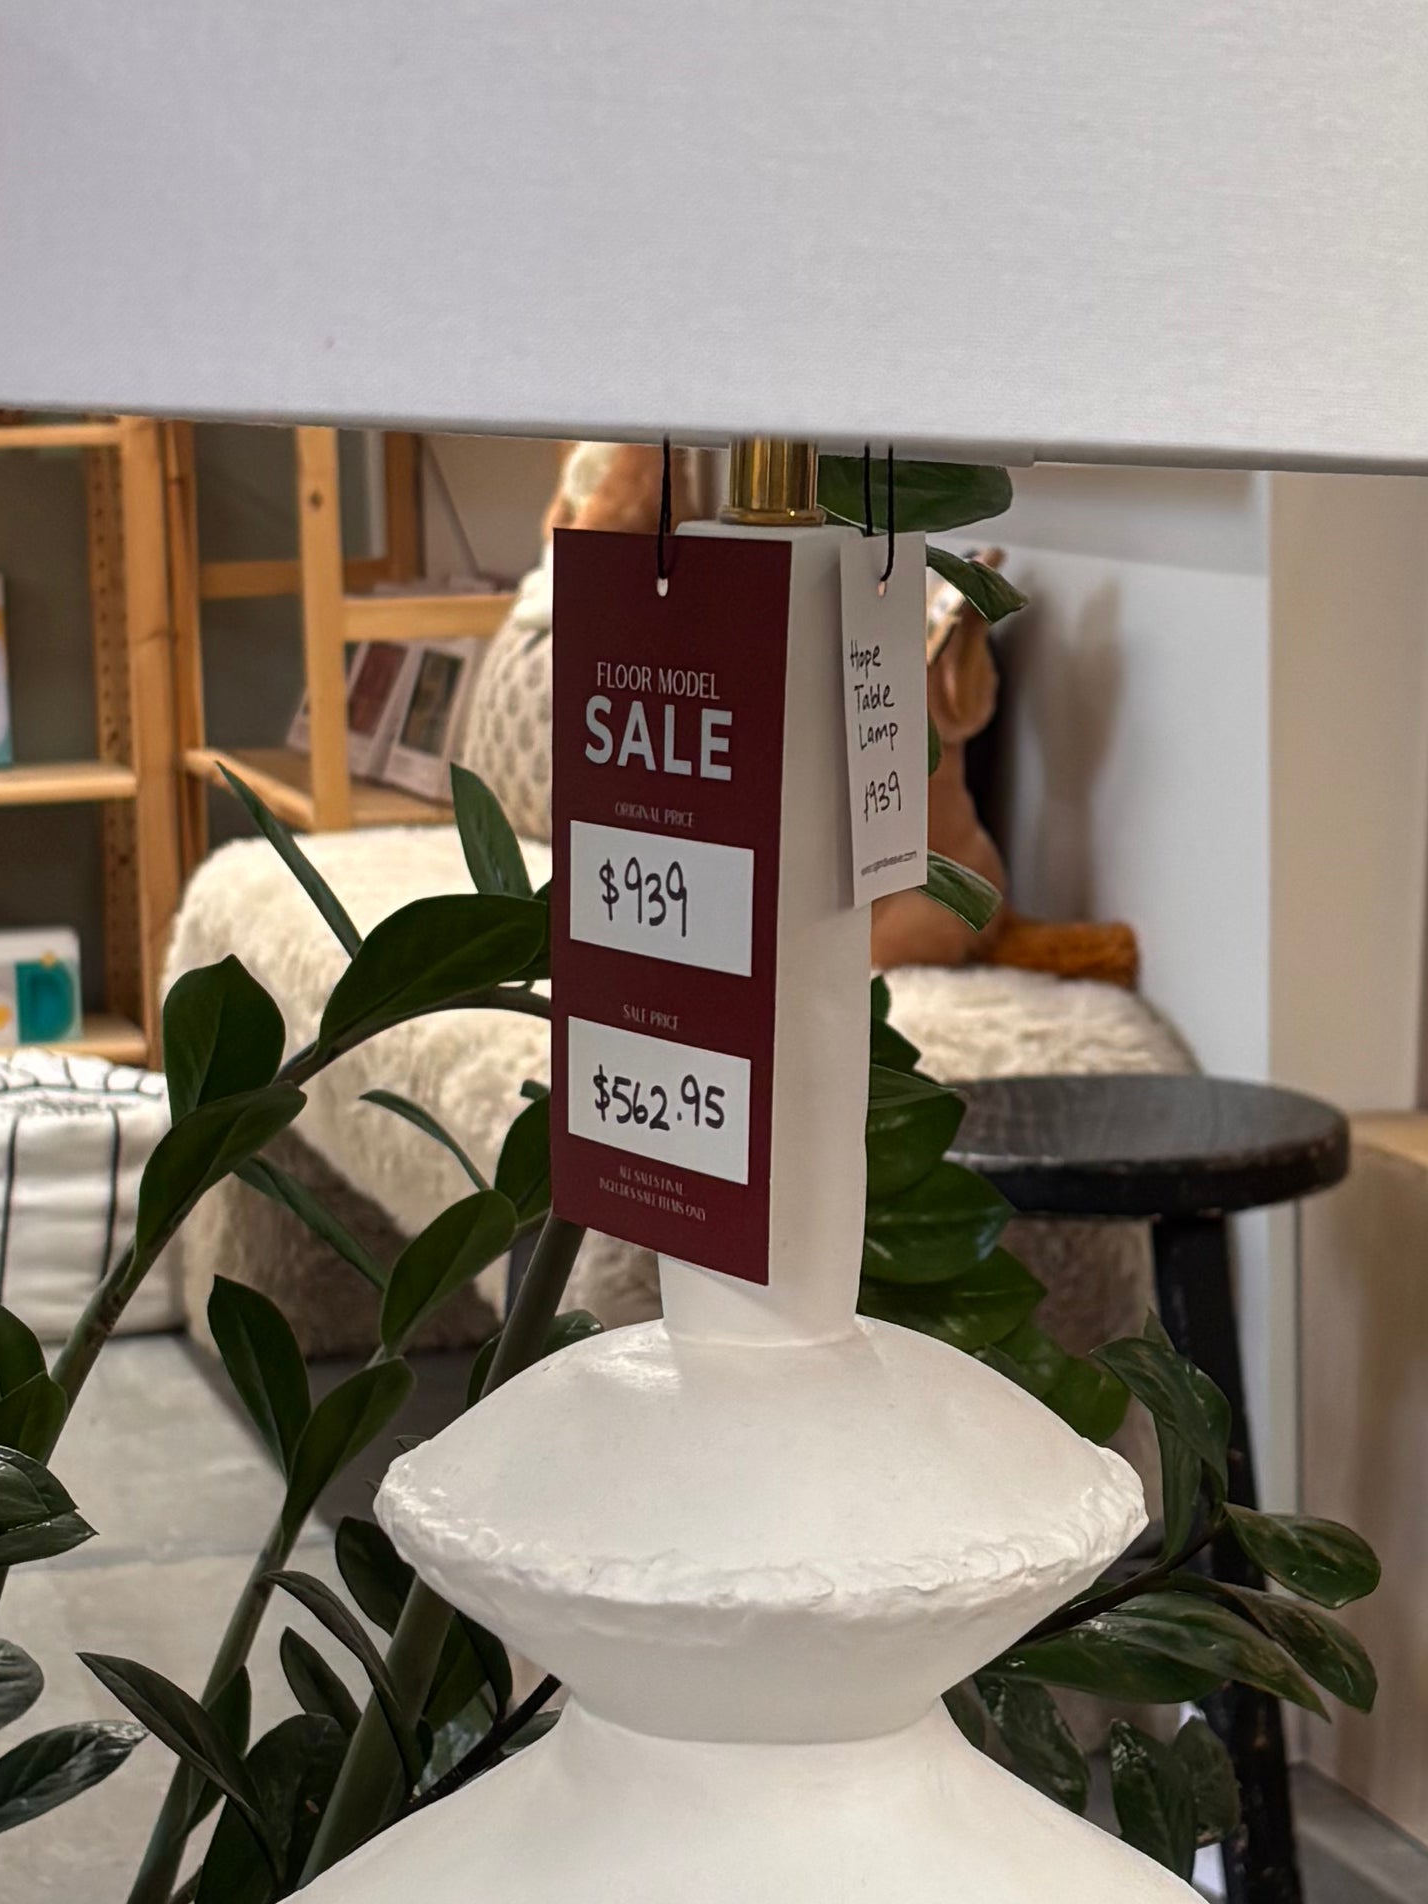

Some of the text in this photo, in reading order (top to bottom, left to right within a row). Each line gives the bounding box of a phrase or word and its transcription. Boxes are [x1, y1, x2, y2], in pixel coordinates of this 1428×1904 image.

[849, 640, 881, 678] Hope
[597, 661, 721, 700] FLOOR MODEL
[854, 684, 895, 715] Table
[585, 695, 733, 782] SALE
[859, 722, 899, 751] Lamp
[615, 801, 694, 828] ORIGINAL PRICE
[599, 856, 688, 938] $939
[623, 1003, 679, 1031] SALE PRICE
[593, 1064, 726, 1131] $562.95
